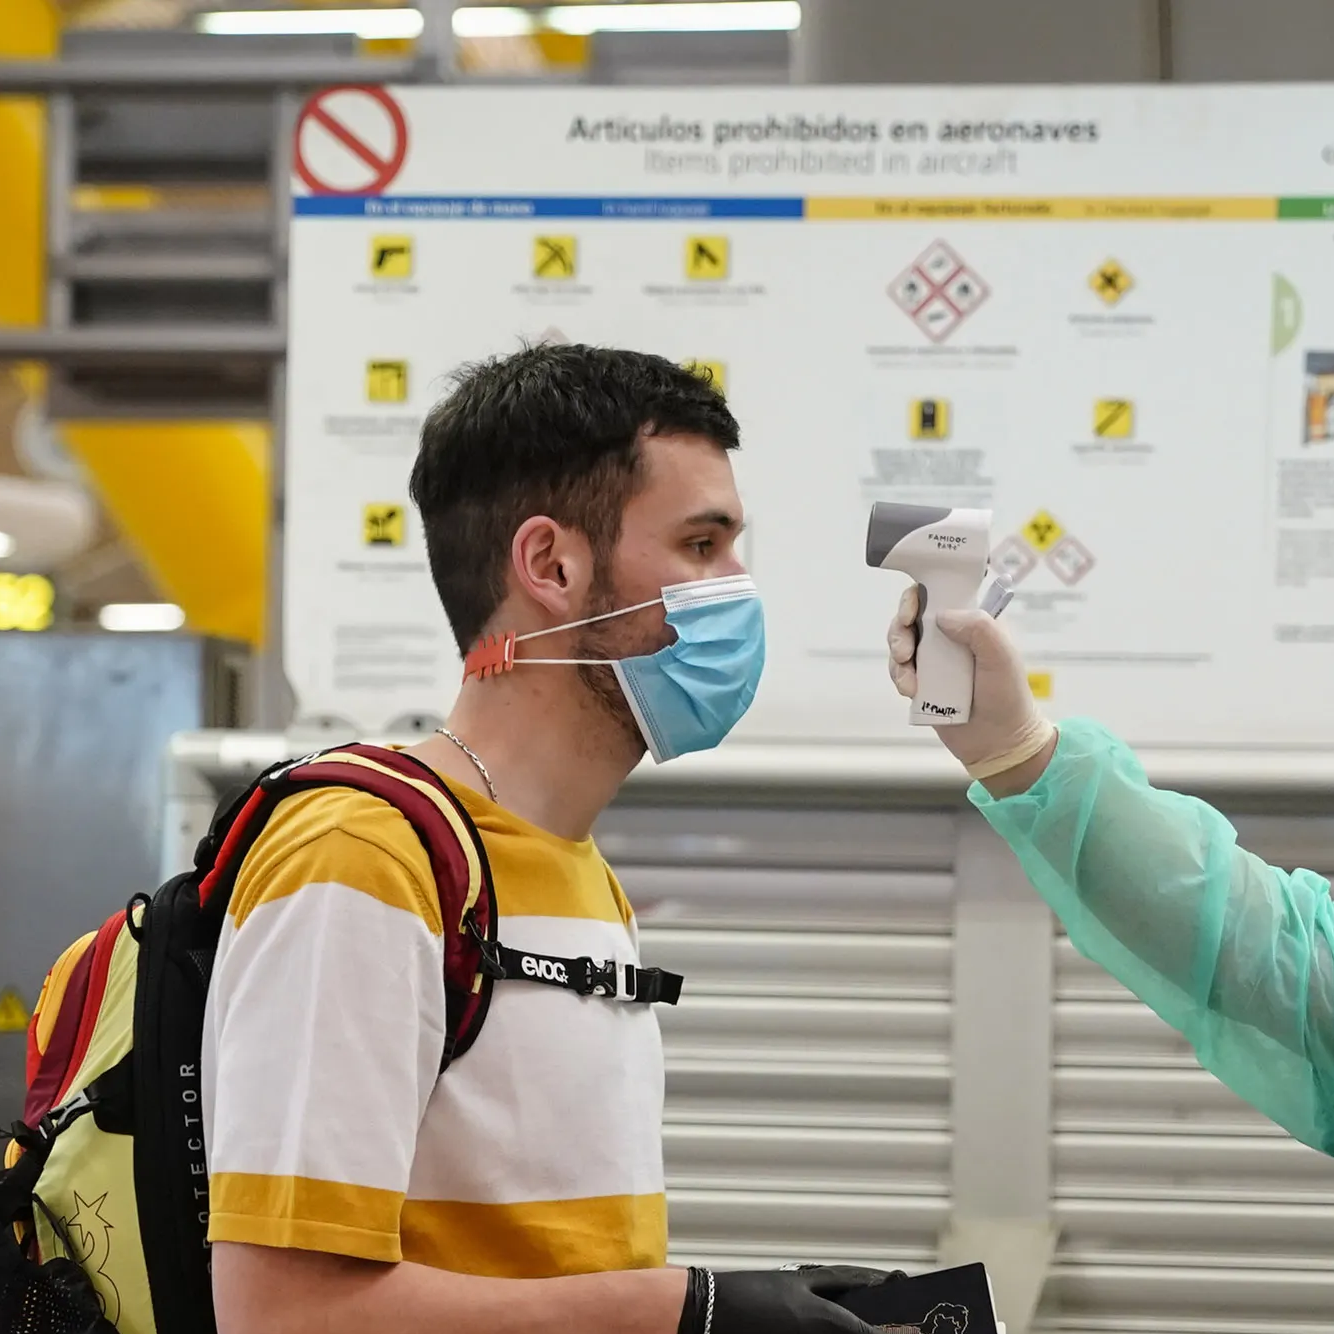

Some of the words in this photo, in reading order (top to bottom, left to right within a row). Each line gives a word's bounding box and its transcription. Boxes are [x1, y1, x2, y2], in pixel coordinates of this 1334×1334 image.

[714, 114, 880, 149] prohibidos
[890, 119, 928, 143] en
[938, 119, 1101, 143] aeronaves
[645, 148, 721, 175] Items
[728, 147, 876, 182] prohibited
[883, 148, 910, 175] in
[918, 147, 1017, 175] aircraft
[1281, 297, 1295, 329] 1
[928, 533, 967, 544] FAMIDOC
[521, 955, 568, 984] evoc
[179, 1063, 212, 1274] ROTECTOR
